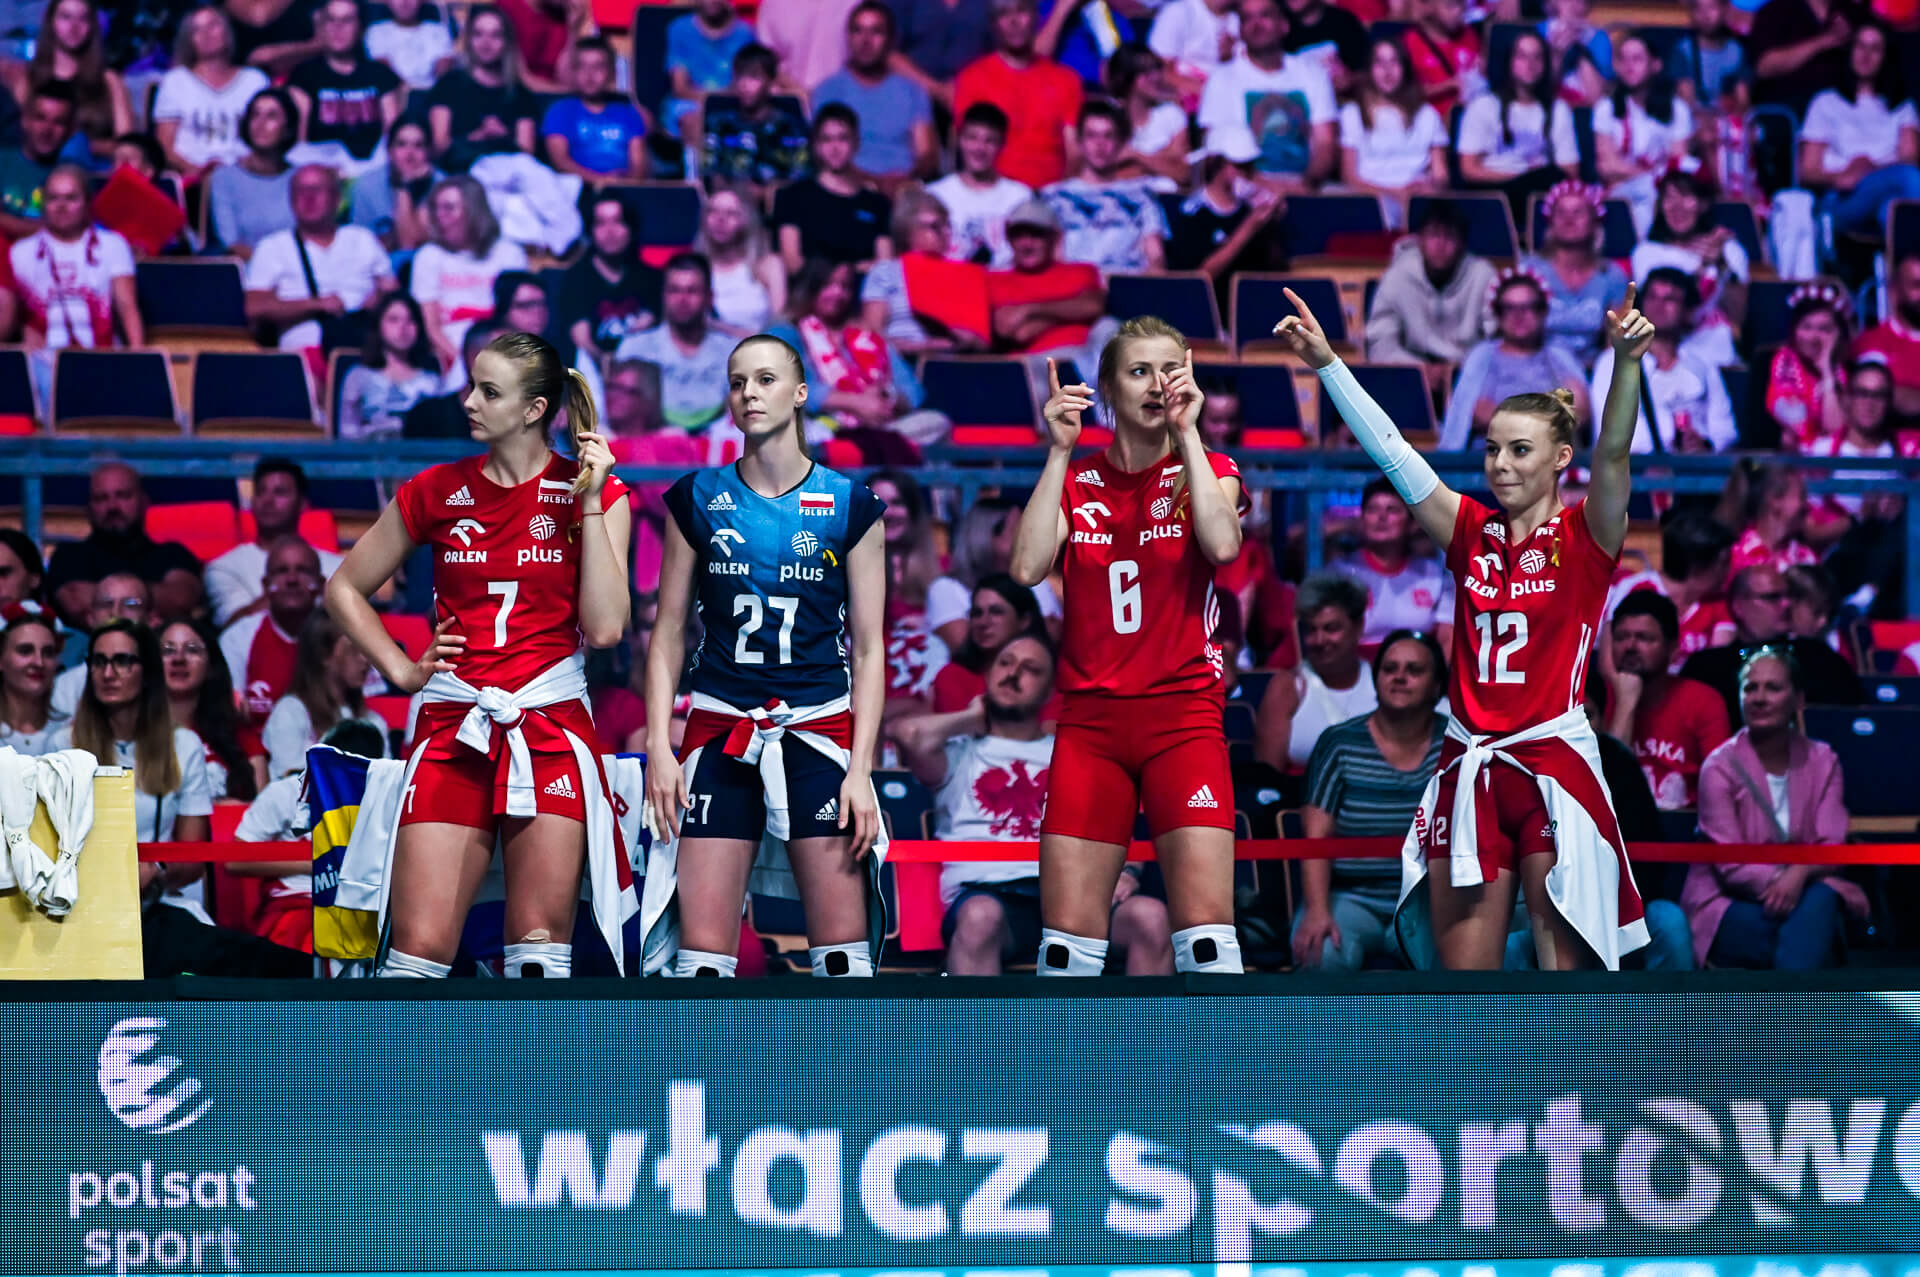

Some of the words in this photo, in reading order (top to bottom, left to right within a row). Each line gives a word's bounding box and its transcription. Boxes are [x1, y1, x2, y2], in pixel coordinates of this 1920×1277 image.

[445, 498, 475, 506] adidas
[707, 503, 737, 511] adidas
[799, 509, 835, 517] POLSKA
[1139, 524, 1183, 546] plus
[444, 551, 487, 563] ORLEN
[517, 545, 563, 566] plus
[708, 562, 750, 575] ORLEN
[779, 562, 824, 582] plus
[1108, 560, 1142, 635] 6
[1464, 575, 1499, 600] RLEN
[1511, 579, 1556, 600] plus
[488, 581, 519, 647] 7
[733, 594, 800, 665] 27
[1475, 612, 1529, 684] 12
[544, 786, 577, 799] adidas
[686, 794, 713, 825] 27
[1187, 799, 1218, 809] adidas
[1431, 816, 1448, 847] 12
[69, 1160, 256, 1219] polsat
[1105, 1091, 1920, 1277] sportow
[85, 1224, 240, 1277] sport
